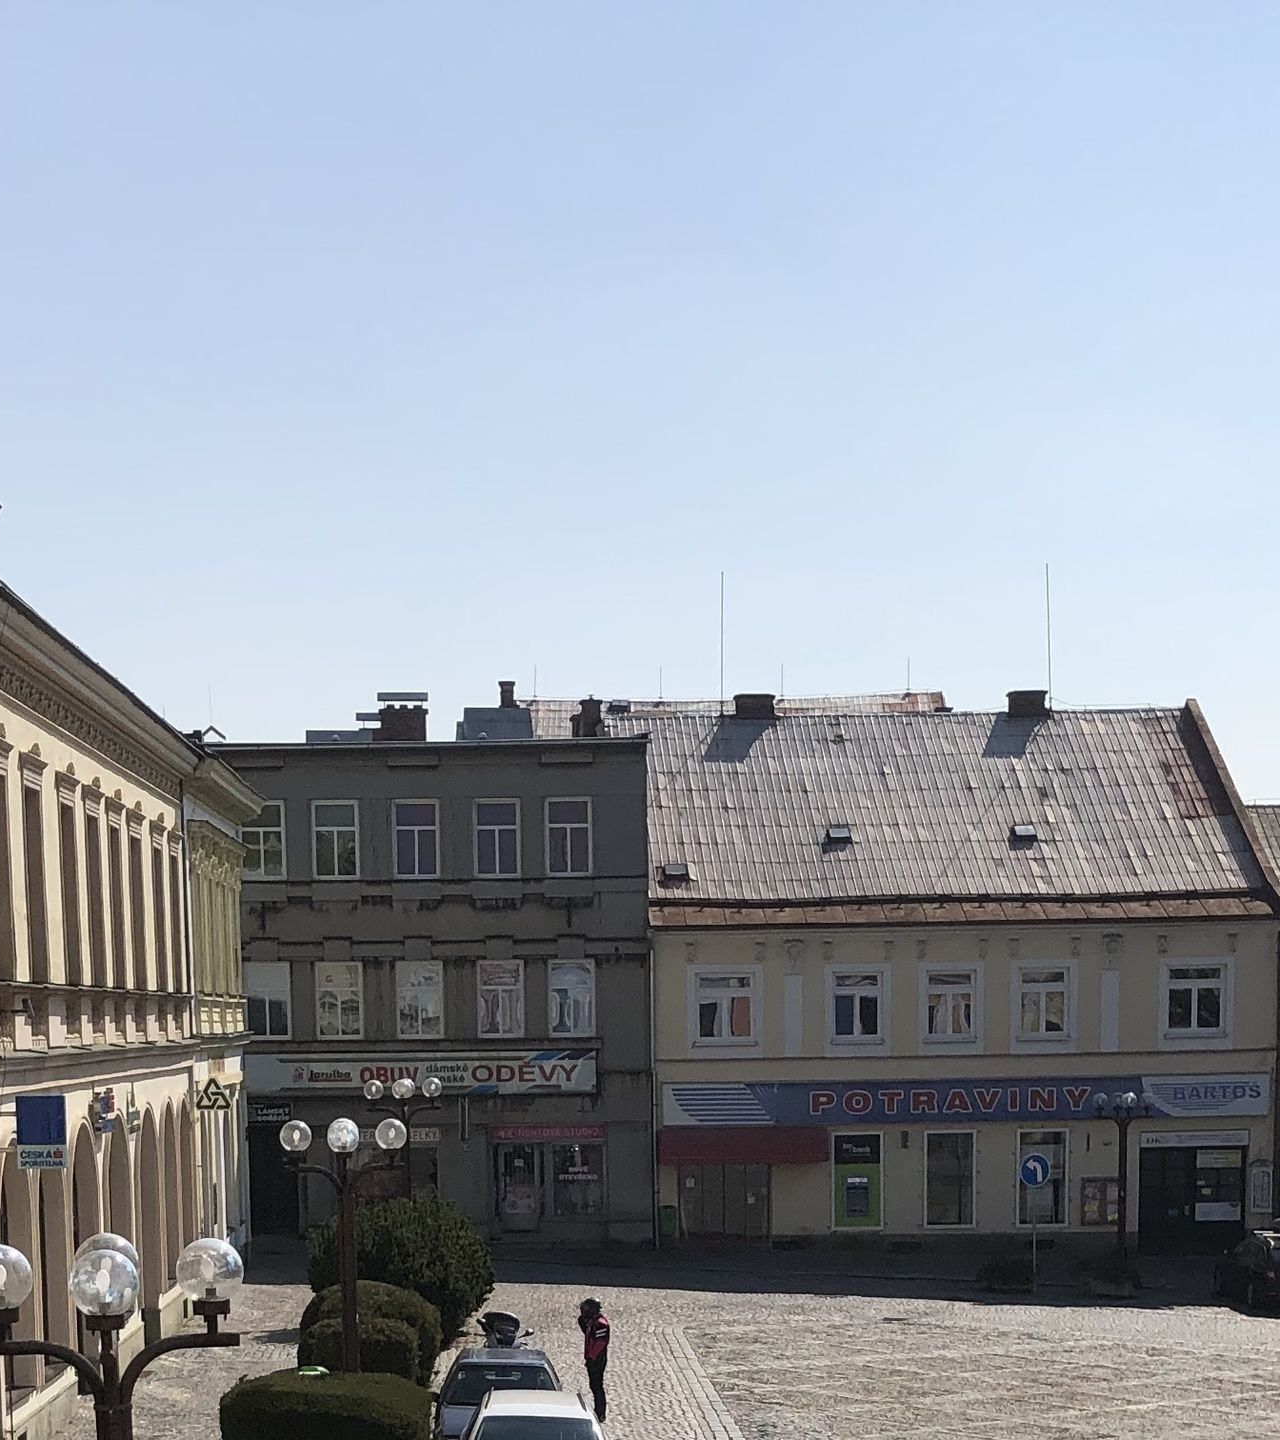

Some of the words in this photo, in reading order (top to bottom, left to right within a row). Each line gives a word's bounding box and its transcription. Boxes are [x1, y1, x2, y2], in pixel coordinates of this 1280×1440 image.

[425, 1063, 469, 1073] dámské
[359, 1066, 418, 1085] OBUV
[809, 1085, 1091, 1115] POTRAVINY
[563, 1127, 599, 1137] STUDIO
